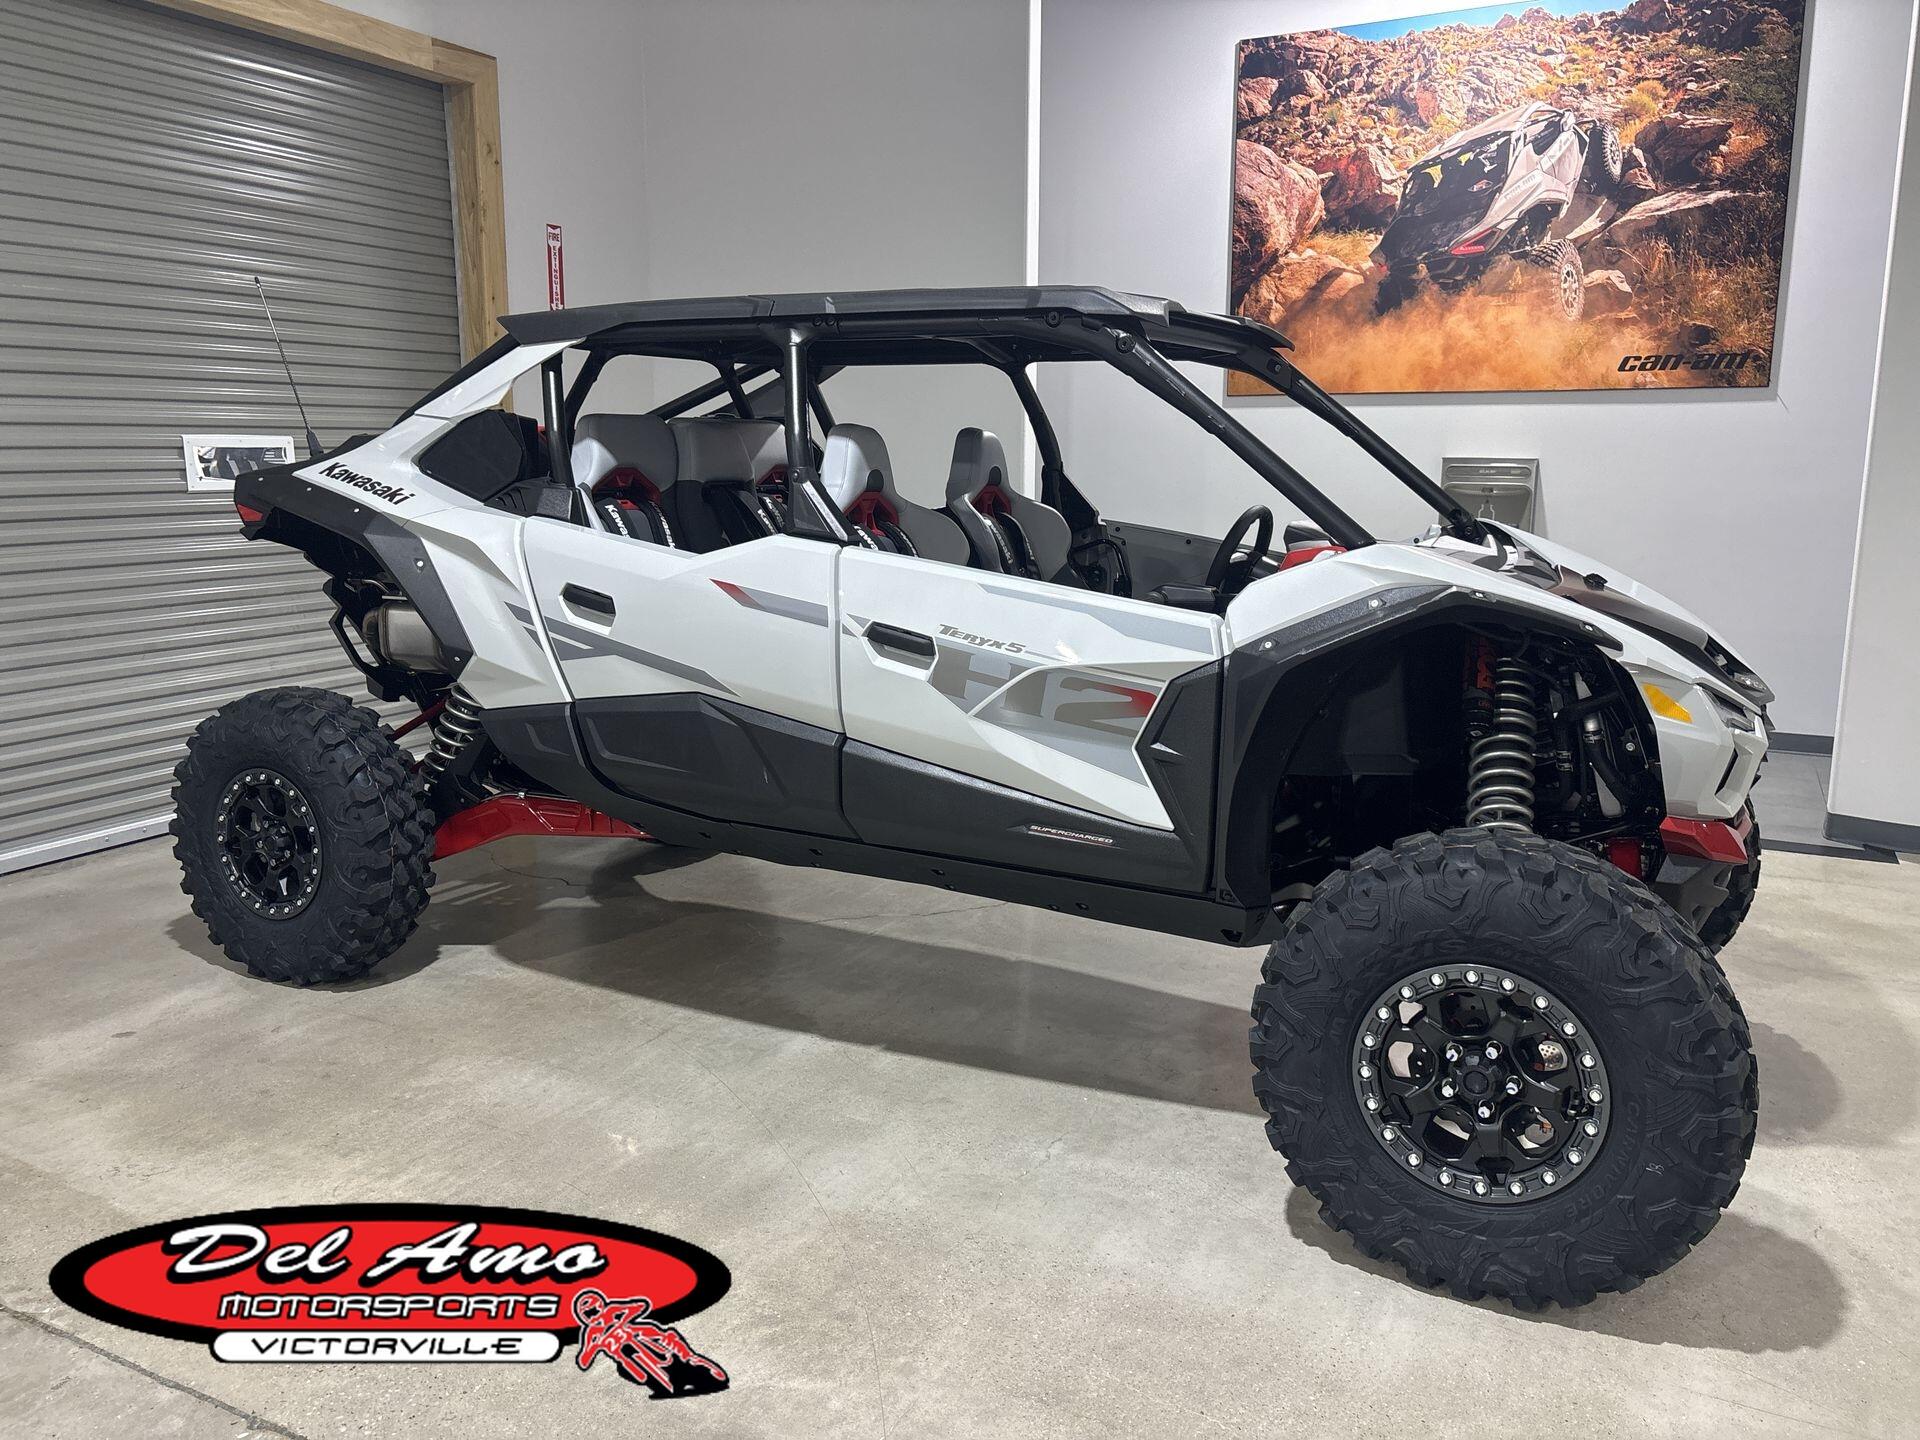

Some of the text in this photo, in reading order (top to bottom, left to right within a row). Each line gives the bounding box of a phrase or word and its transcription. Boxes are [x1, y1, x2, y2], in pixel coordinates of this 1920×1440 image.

[548, 232, 560, 242] FIRE
[552, 245, 561, 311] EXTINGUISHE
[1617, 352, 1752, 373] can-am
[318, 462, 417, 506] Kawasaki
[1029, 825, 1114, 845] SUPERCHARGED
